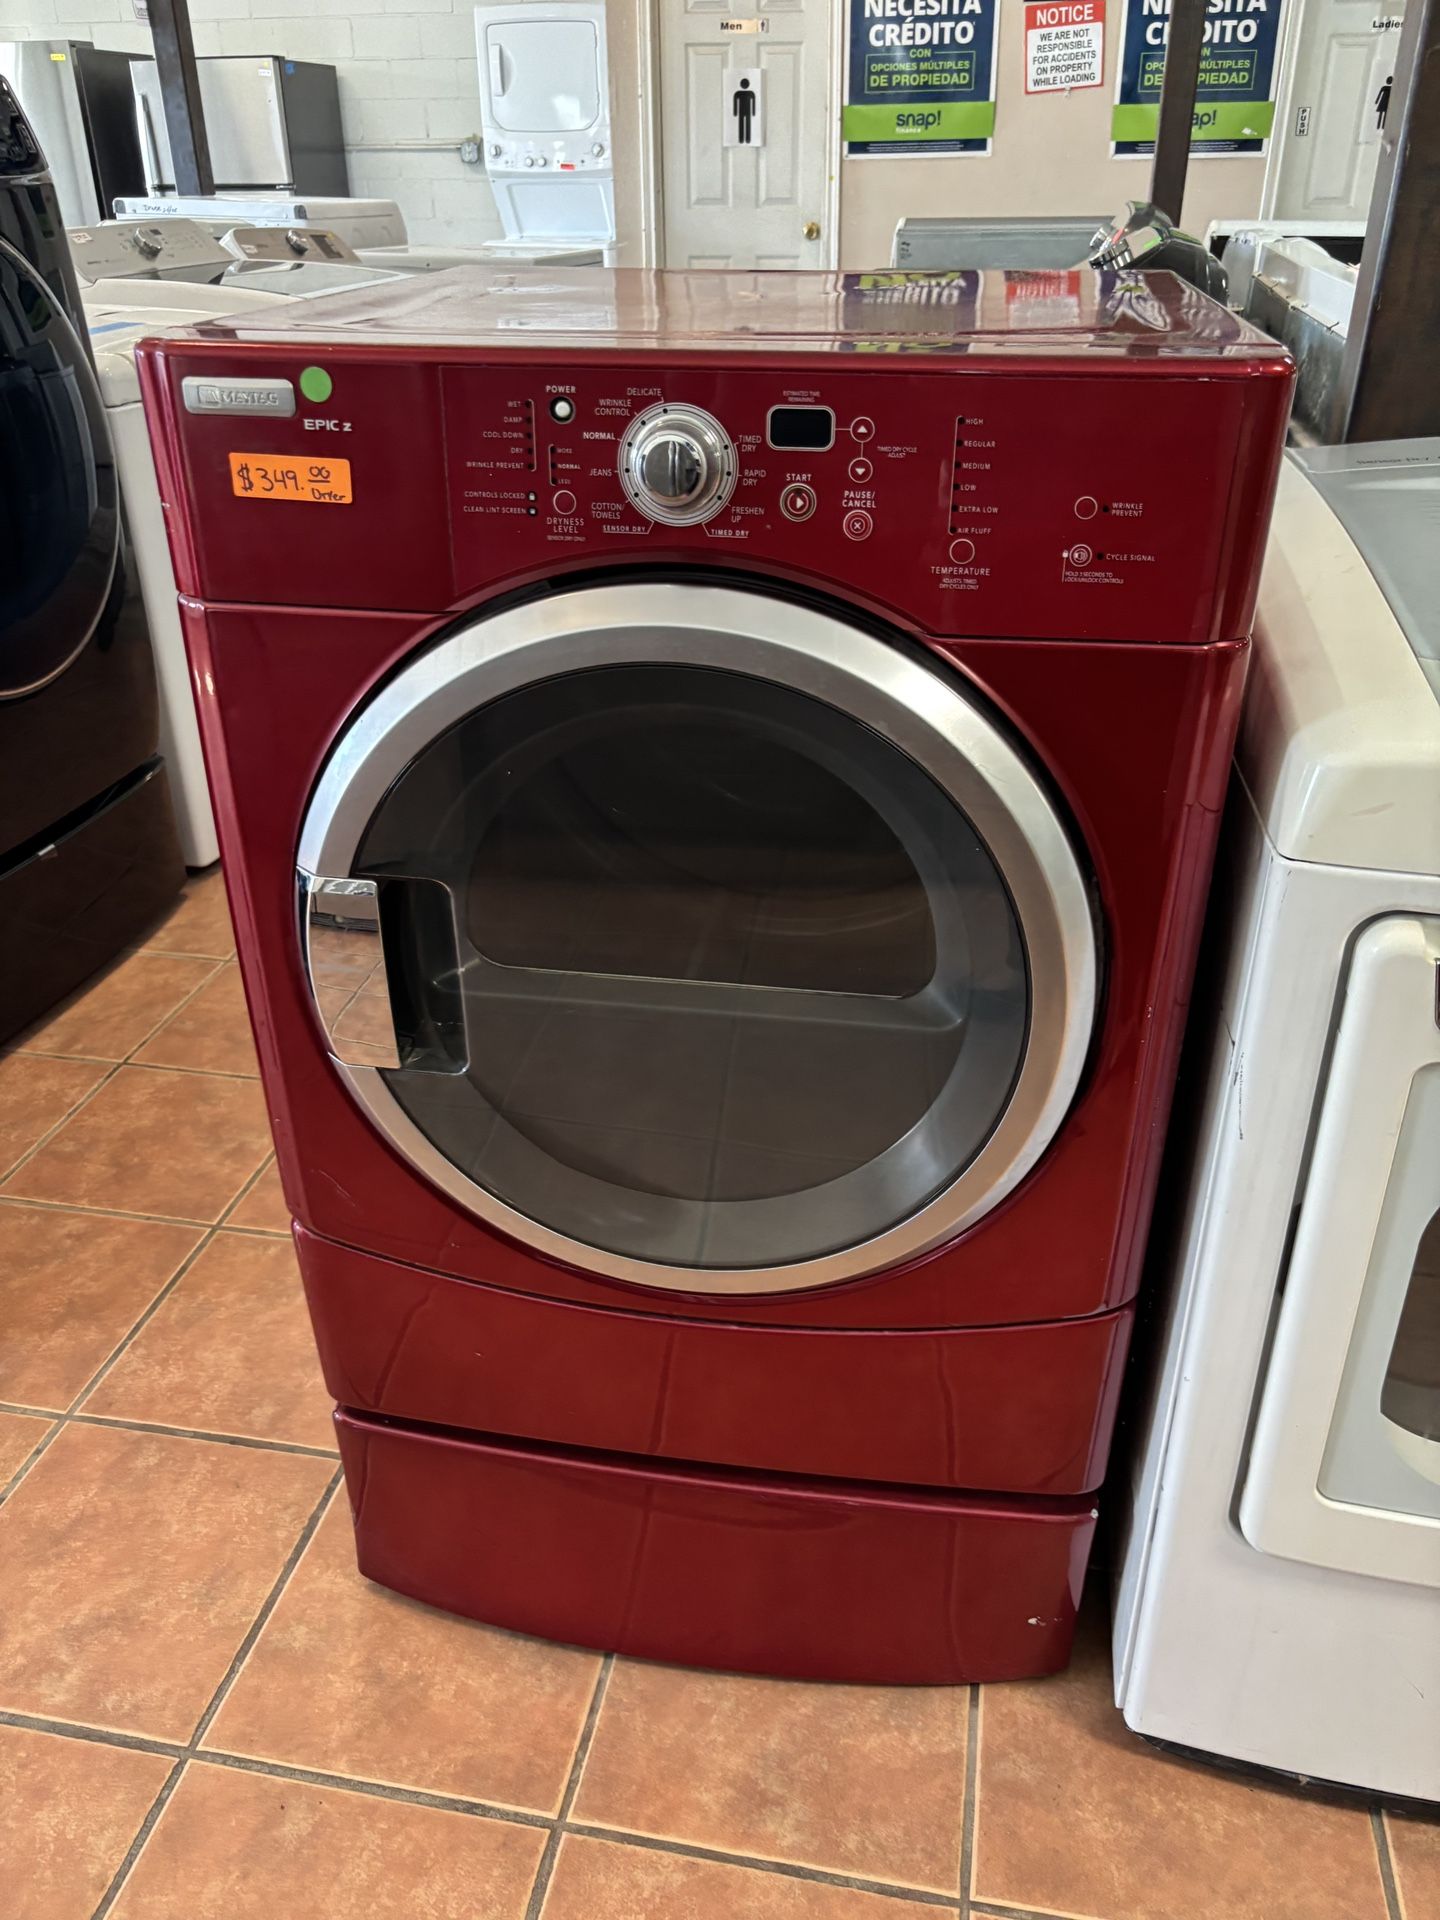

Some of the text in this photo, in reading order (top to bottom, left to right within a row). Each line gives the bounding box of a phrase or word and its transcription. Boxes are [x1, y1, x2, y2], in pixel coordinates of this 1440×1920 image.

[1036, 4, 1094, 26] NOTICE
[720, 22, 742, 30] Men
[869, 17, 975, 47] CRÉDITO
[1040, 28, 1090, 42] WE ARE NOT
[1146, 19, 1258, 45] CDITO
[1037, 40, 1093, 53] RESPONSIBLE
[909, 48, 932, 58] CON
[1033, 50, 1096, 65] FOR ACCIDENTS
[870, 60, 970, 72] OPCIONES MÚLTIPLES
[1036, 62, 1093, 76] ON PROPERTY
[870, 72, 970, 87] DE PROPIEDAD
[1033, 73, 1096, 87] WHILE LOADING
[1197, 72, 1249, 85] PIEDAD
[896, 110, 942, 130] snap!
[1298, 109, 1307, 134] PUSH
[545, 385, 576, 393] POWER
[627, 388, 662, 396] DELICATE
[599, 399, 632, 407] WRINKLE
[595, 408, 630, 416] CONTROL
[303, 418, 340, 431] EPIC
[583, 432, 616, 440] NORMAL
[739, 435, 762, 443] TIMED
[742, 444, 756, 452] DRY
[964, 440, 996, 448] REGULAR
[590, 469, 612, 477] JEANS
[744, 470, 766, 478] RAPID
[743, 478, 758, 486] DRY
[464, 491, 498, 499] CONTROLS
[844, 490, 875, 499] PAUSE/
[591, 502, 625, 511] COTTON/
[842, 500, 877, 508] CANCEL
[1112, 502, 1143, 510] WRINKLE
[731, 506, 765, 515] FRESHEN
[982, 506, 999, 514] LOW
[1111, 509, 1143, 517] PREVENT
[592, 511, 621, 520] TOWELS
[731, 515, 742, 523] UP
[546, 517, 584, 525] DRYNESS
[553, 525, 579, 533] LEVEL
[1106, 553, 1156, 562] CYCLE SIGNAL
[930, 566, 991, 576] TEMPERATURE
